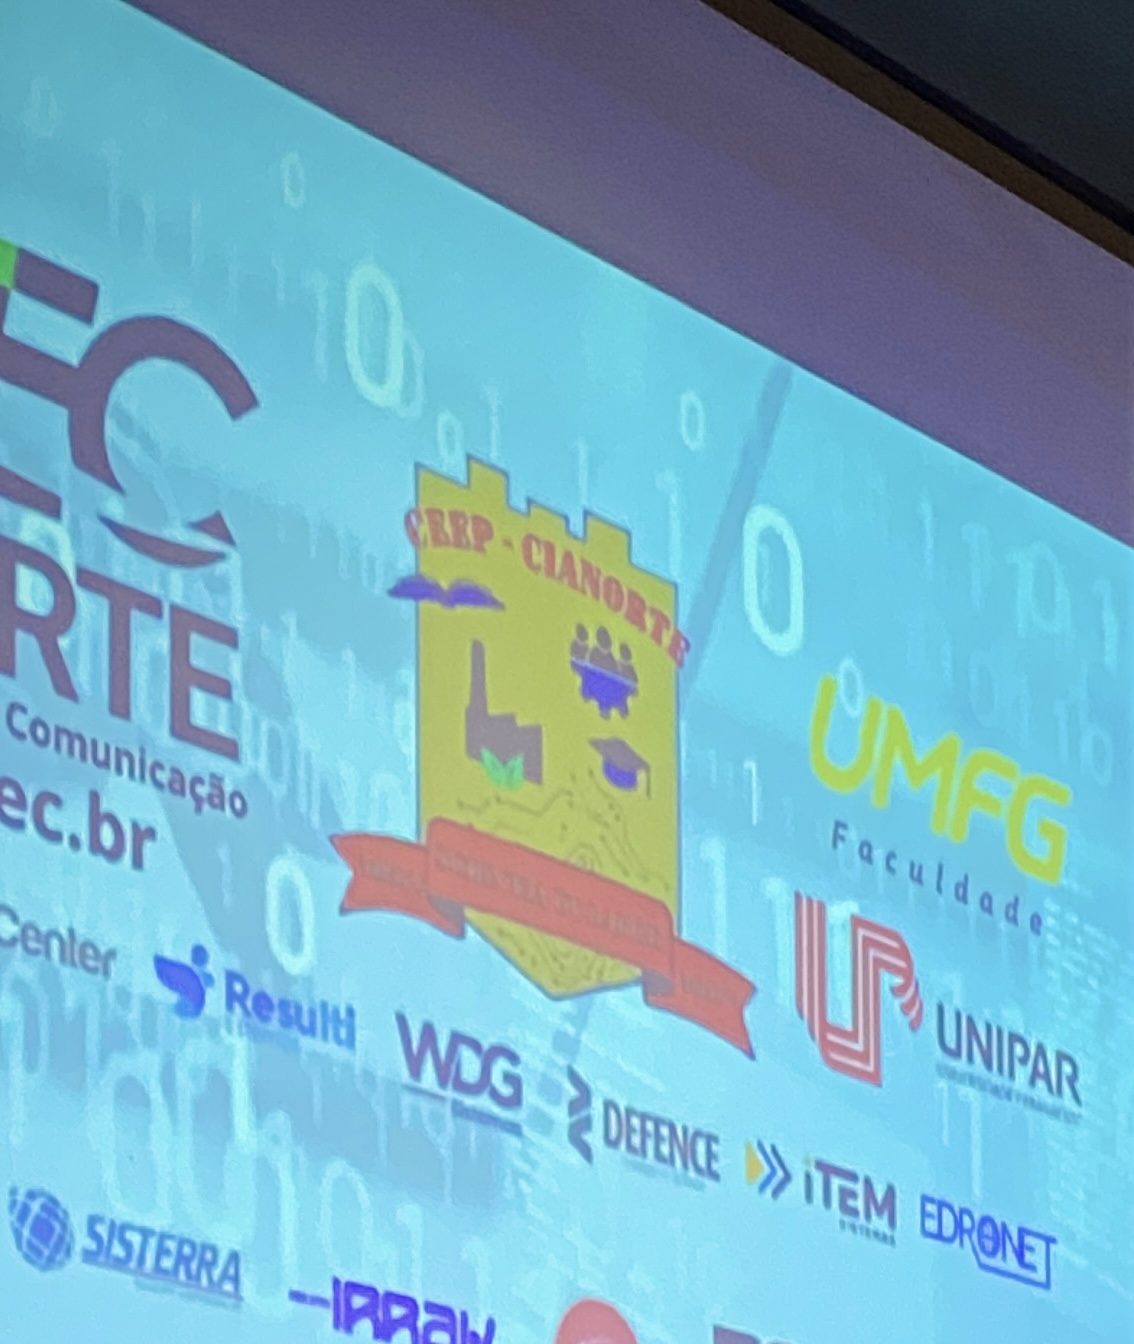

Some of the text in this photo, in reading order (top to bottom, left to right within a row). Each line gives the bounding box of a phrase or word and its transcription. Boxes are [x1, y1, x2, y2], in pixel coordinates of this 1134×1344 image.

[521, 532, 690, 669] CIANORTE
[5, 701, 248, 820] Comunicação
[809, 673, 1071, 885] UMFG
[832, 820, 1044, 936] Faculdade
[395, 1011, 523, 1110] WDG
[936, 1001, 1083, 1107] UNIPAR
[603, 1098, 720, 1182] DEFENCE
[83, 1214, 242, 1294] SISTERRA
[919, 1194, 1058, 1291] EDRONET
